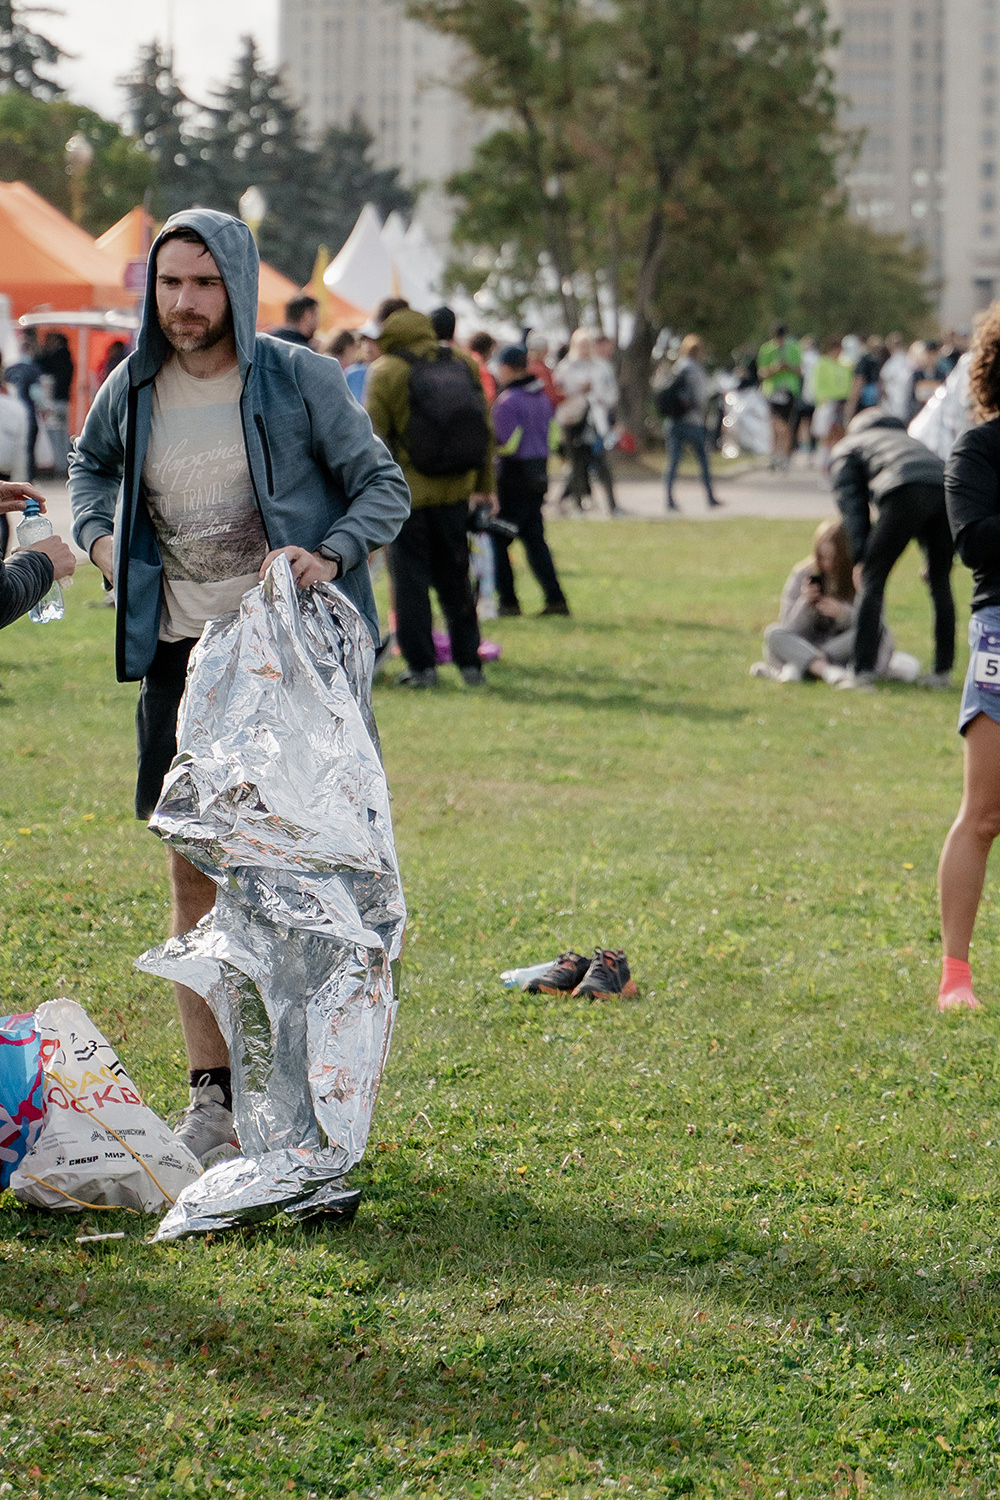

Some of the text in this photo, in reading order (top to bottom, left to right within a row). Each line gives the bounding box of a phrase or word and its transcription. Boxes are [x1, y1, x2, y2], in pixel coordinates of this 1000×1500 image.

[152, 439, 247, 491] Happines
[180, 481, 225, 512] TRAVEL
[167, 517, 231, 545] destination
[43, 1084, 146, 1115] ОСКВ
[68, 1155, 99, 1166] СИБУР
